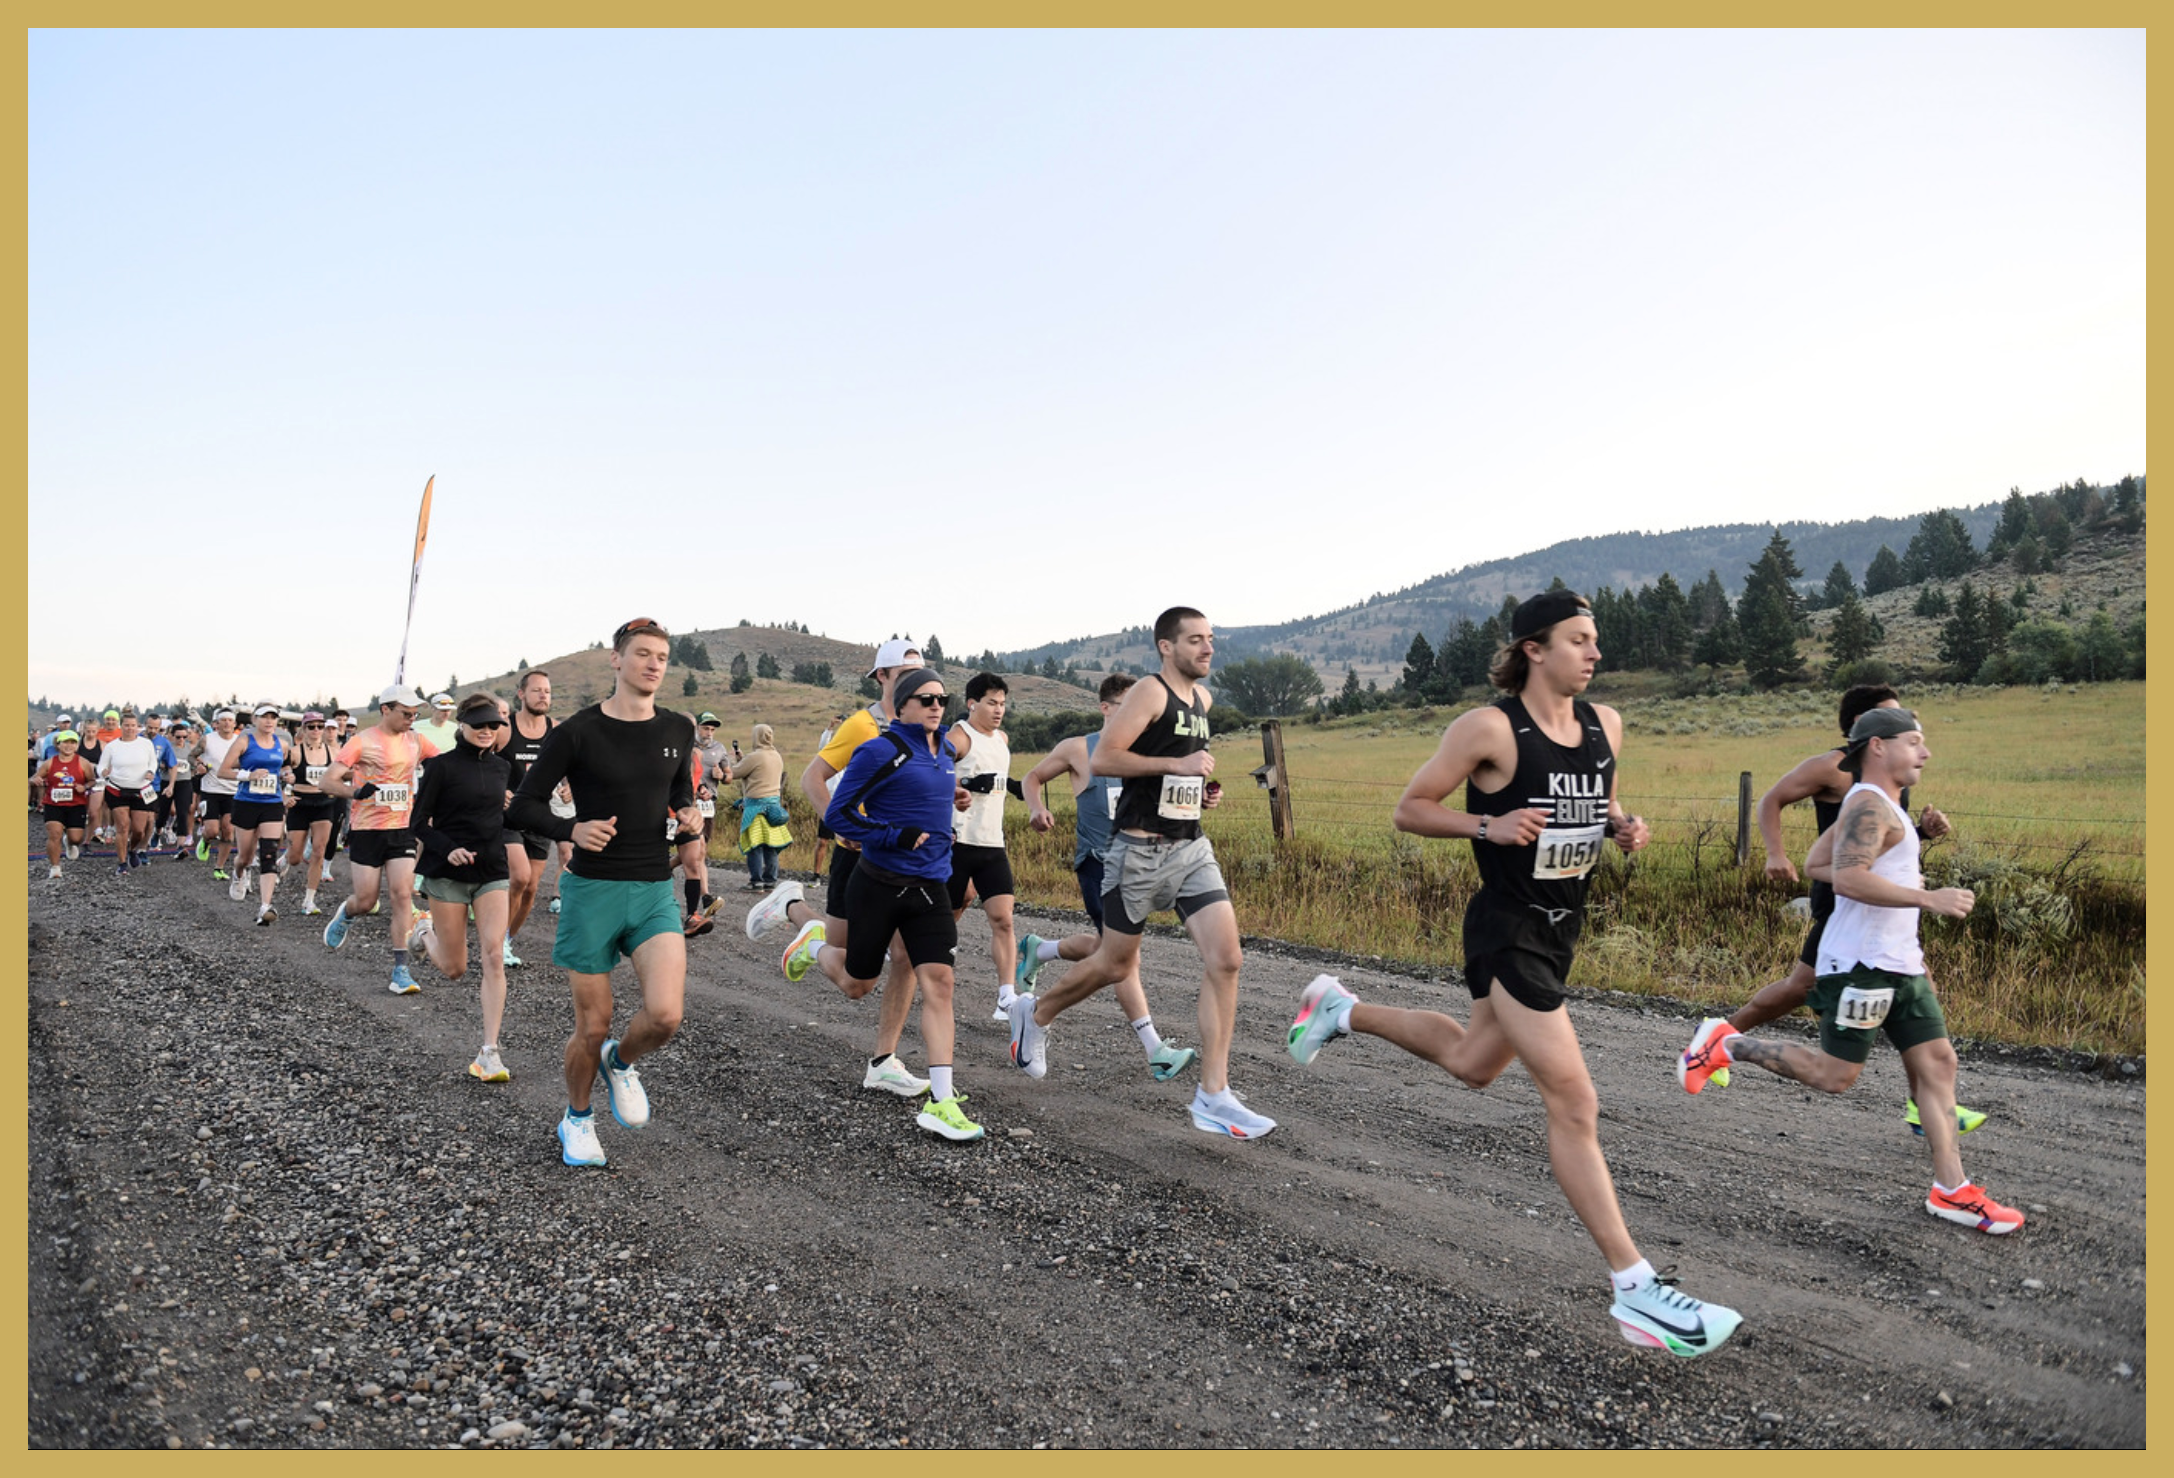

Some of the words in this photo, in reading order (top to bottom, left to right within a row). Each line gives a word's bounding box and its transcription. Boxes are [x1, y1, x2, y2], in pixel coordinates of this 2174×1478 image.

[380, 789, 407, 802] 1038
[1548, 773, 1604, 797] KILLA
[1557, 799, 1597, 823] ELITE
[1545, 841, 1597, 869] 1051
